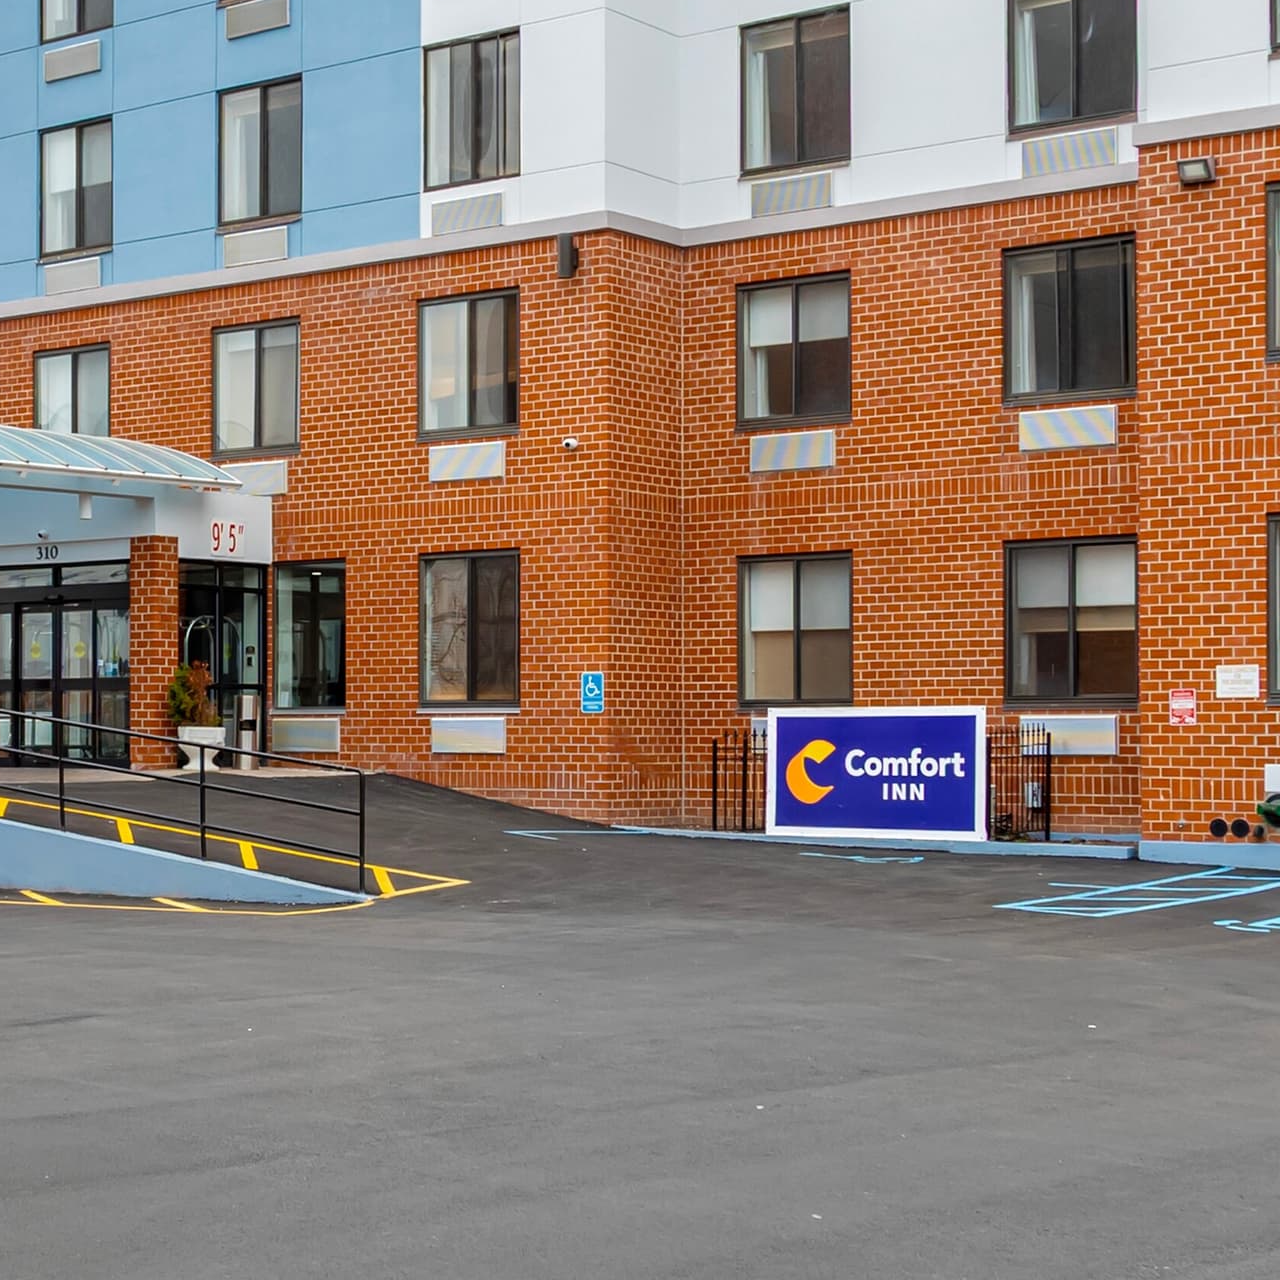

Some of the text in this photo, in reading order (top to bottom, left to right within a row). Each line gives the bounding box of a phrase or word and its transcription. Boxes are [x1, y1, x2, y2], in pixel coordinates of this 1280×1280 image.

[36, 545, 59, 560] 310
[845, 747, 965, 777] Comfort
[882, 783, 925, 801] INN
